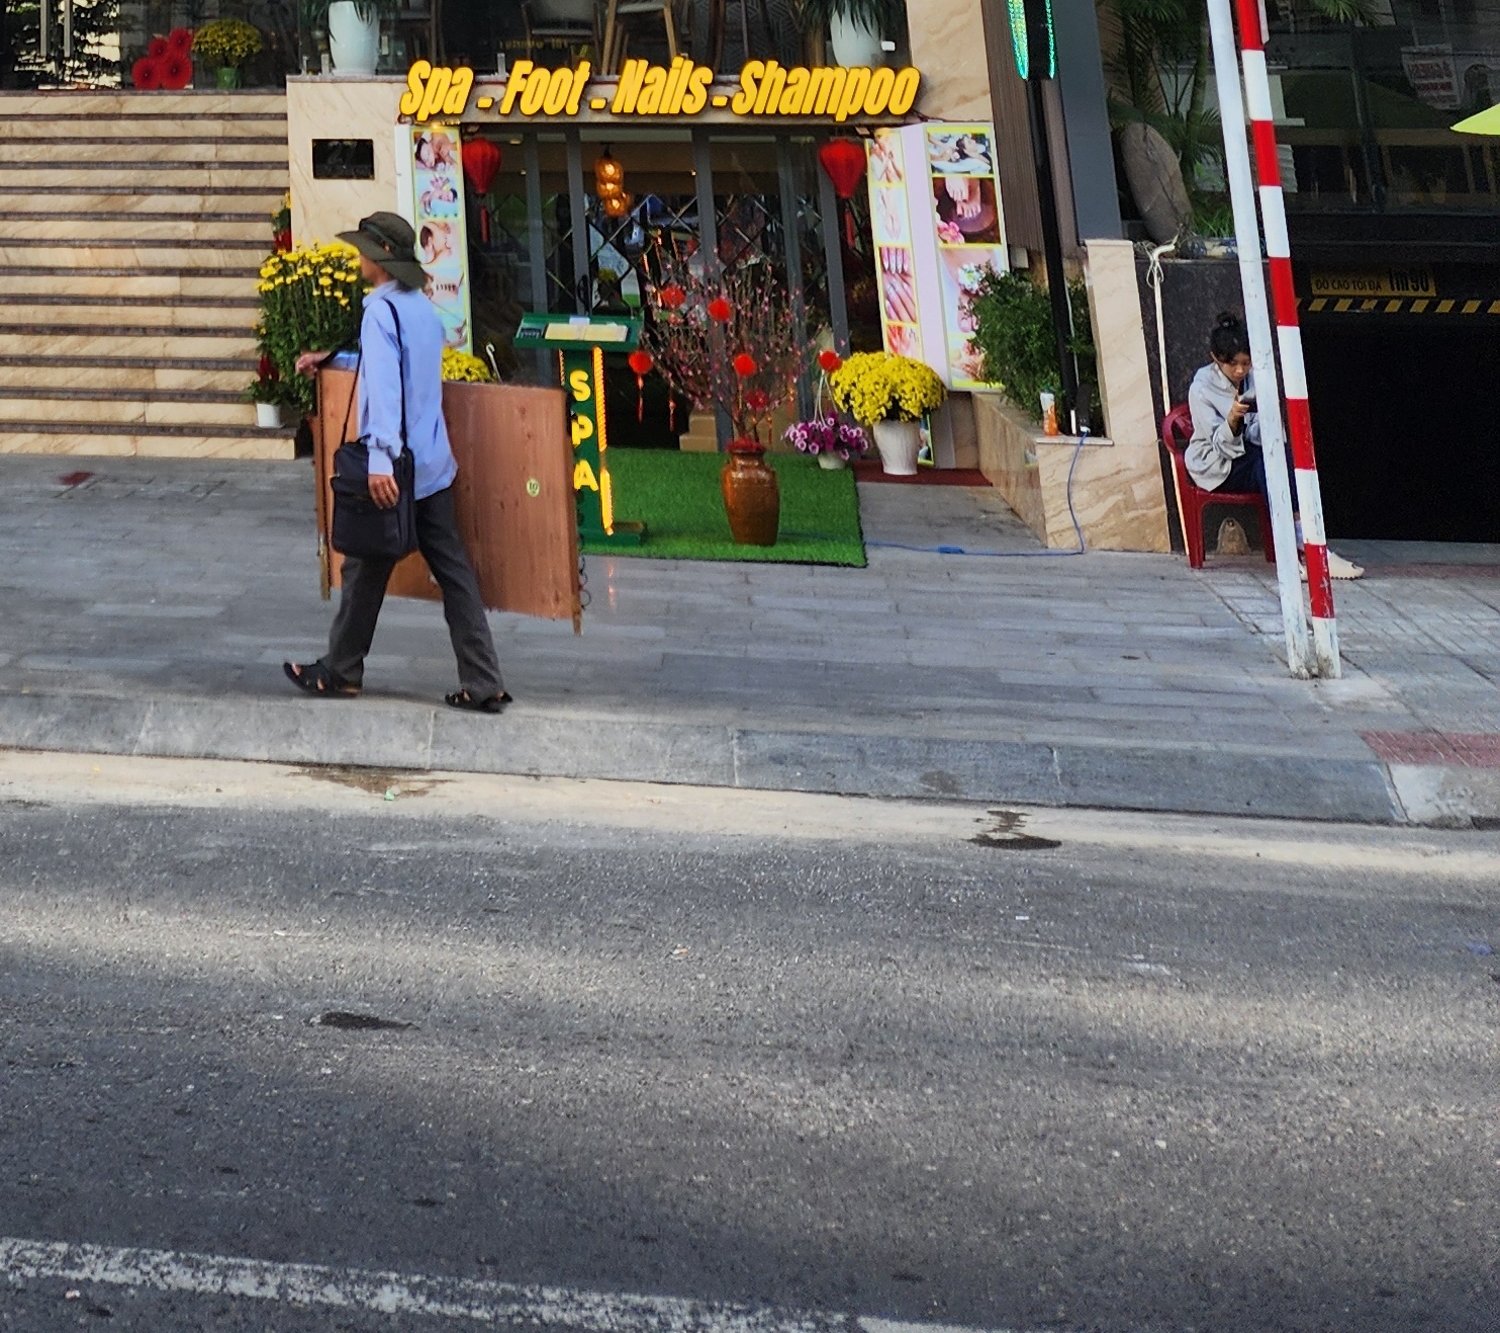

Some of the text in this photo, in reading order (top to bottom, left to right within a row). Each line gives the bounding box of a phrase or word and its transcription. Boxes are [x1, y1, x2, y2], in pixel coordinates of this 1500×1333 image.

[399, 60, 474, 122] Spa
[500, 59, 591, 117] Foot
[611, 56, 714, 116] Nails
[732, 60, 921, 122] Shampoo
[569, 369, 599, 492] SPA
